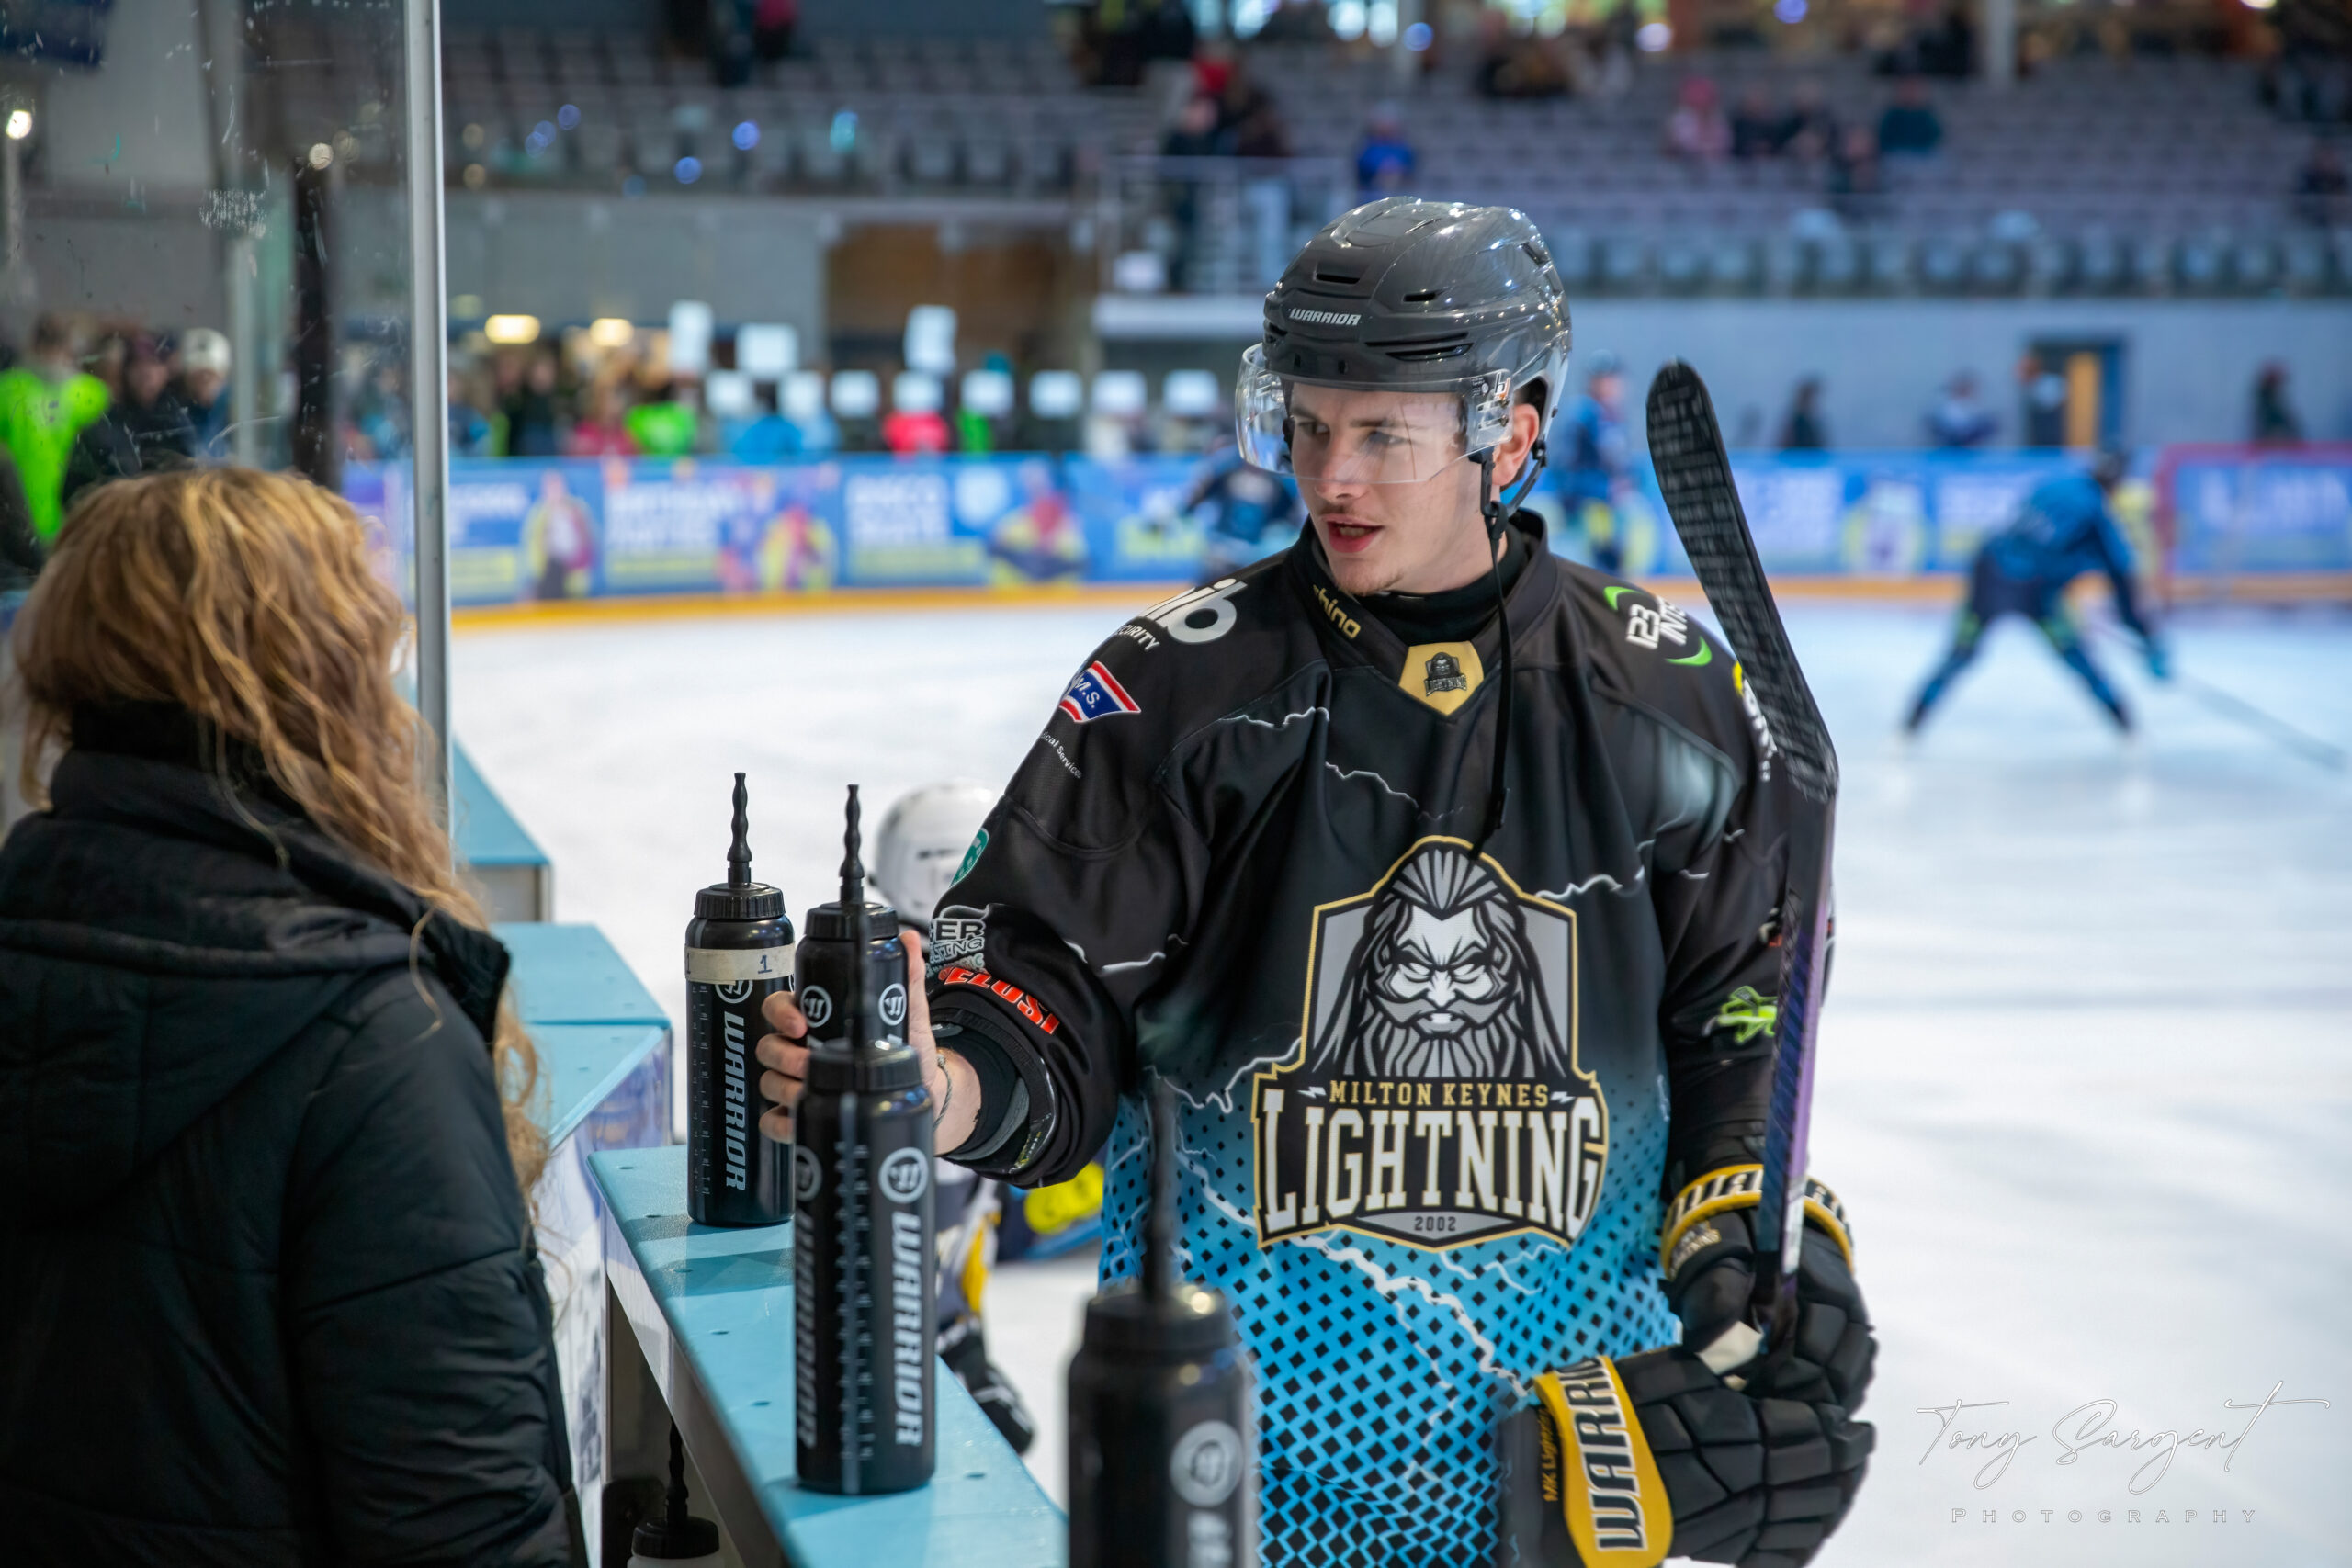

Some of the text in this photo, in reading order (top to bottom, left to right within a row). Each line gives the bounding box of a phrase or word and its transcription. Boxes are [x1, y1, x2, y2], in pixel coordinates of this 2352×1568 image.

[1289, 308, 1362, 326] WARRIOR
[757, 954, 773, 975] 1
[723, 1010, 746, 1191] WARRIOR
[1329, 1080, 1549, 1107] MILTON KEYNES
[1262, 1088, 1600, 1239] LIGHTNING
[1414, 1215, 1457, 1232] 2002
[891, 1211, 923, 1447] WARRIOR
